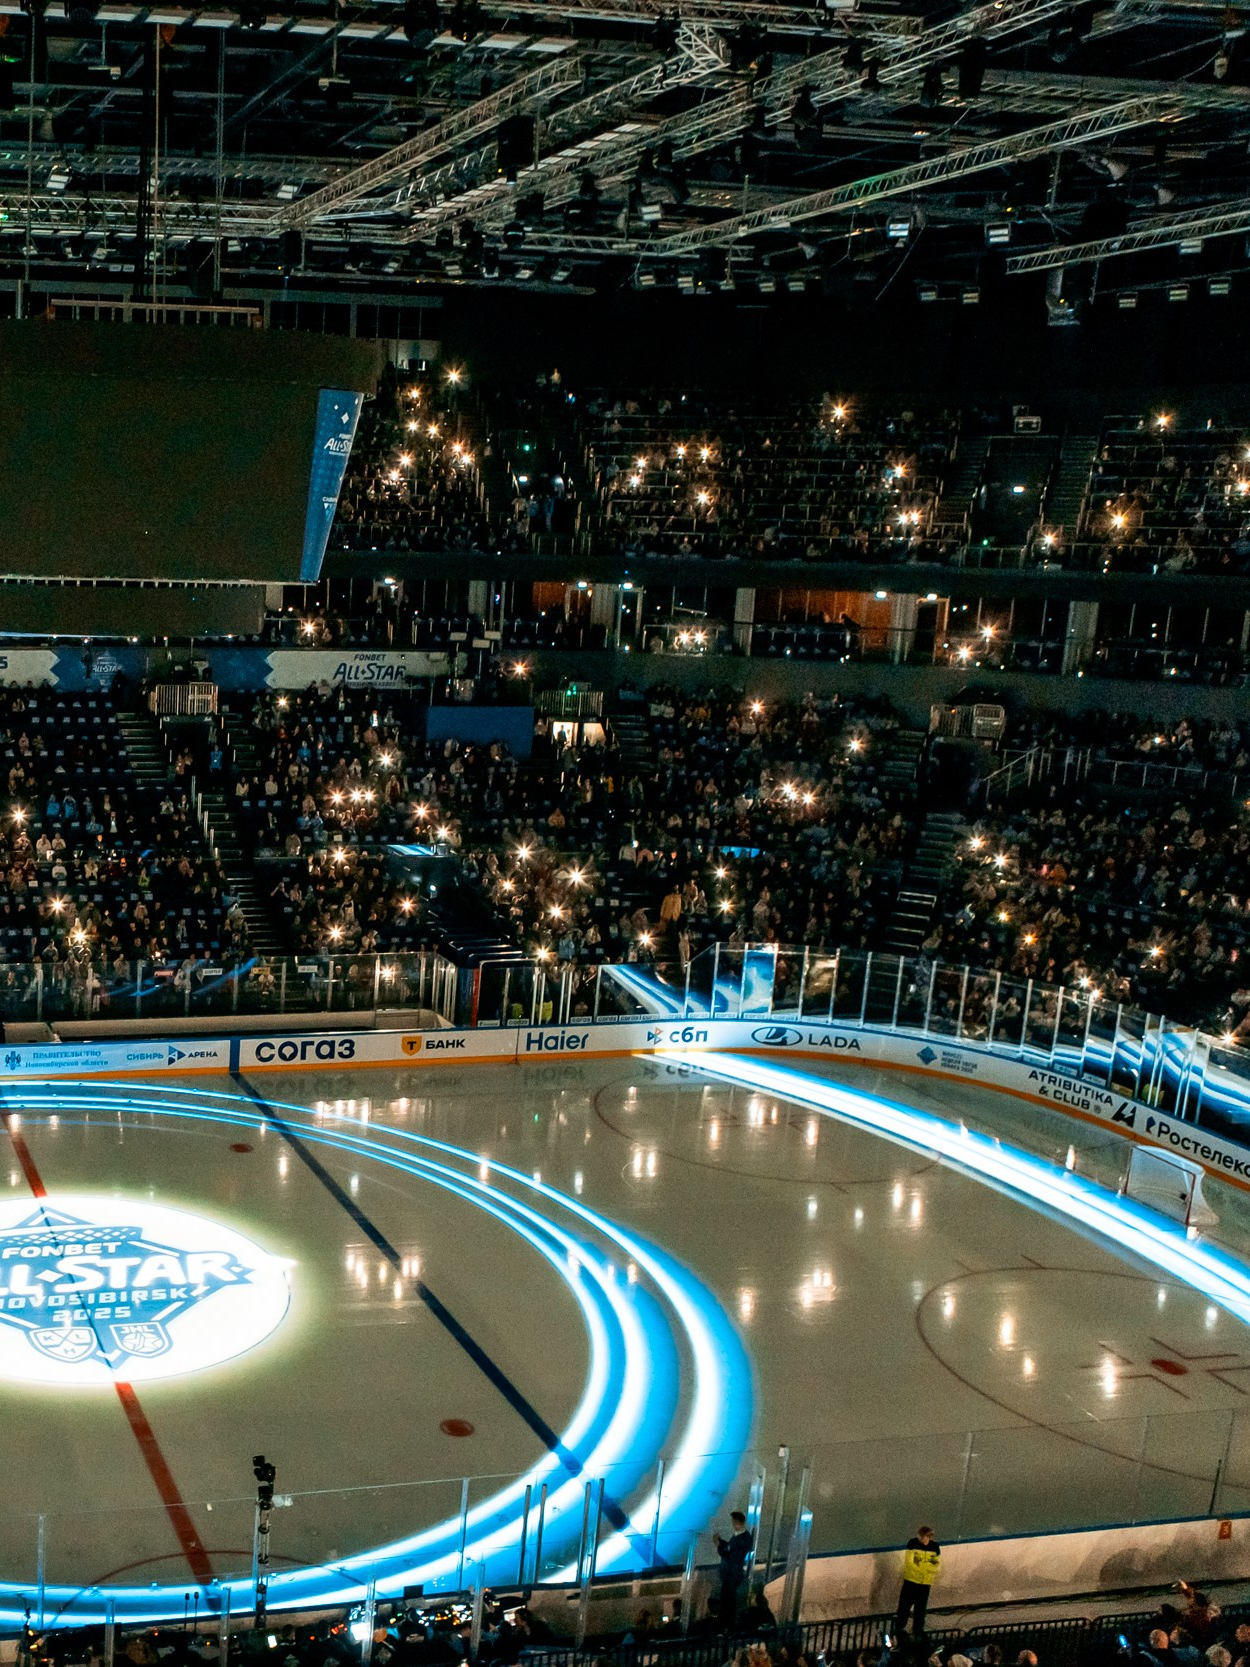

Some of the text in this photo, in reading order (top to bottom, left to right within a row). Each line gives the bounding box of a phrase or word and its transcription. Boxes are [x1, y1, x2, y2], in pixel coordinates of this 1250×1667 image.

[425, 1038, 466, 1049] БАНК
[526, 1030, 589, 1051] Haier
[669, 1026, 708, 1043] сбп
[808, 1033, 861, 1051] LADA
[127, 1050, 218, 1061] СИБИРЬ АРЕНА
[1028, 1070, 1114, 1106] ATRIBUTIKA
[1038, 1086, 1090, 1110] & CLUB
[1, 1241, 122, 1259] FONBET
[52, 1306, 132, 1322] 2025
